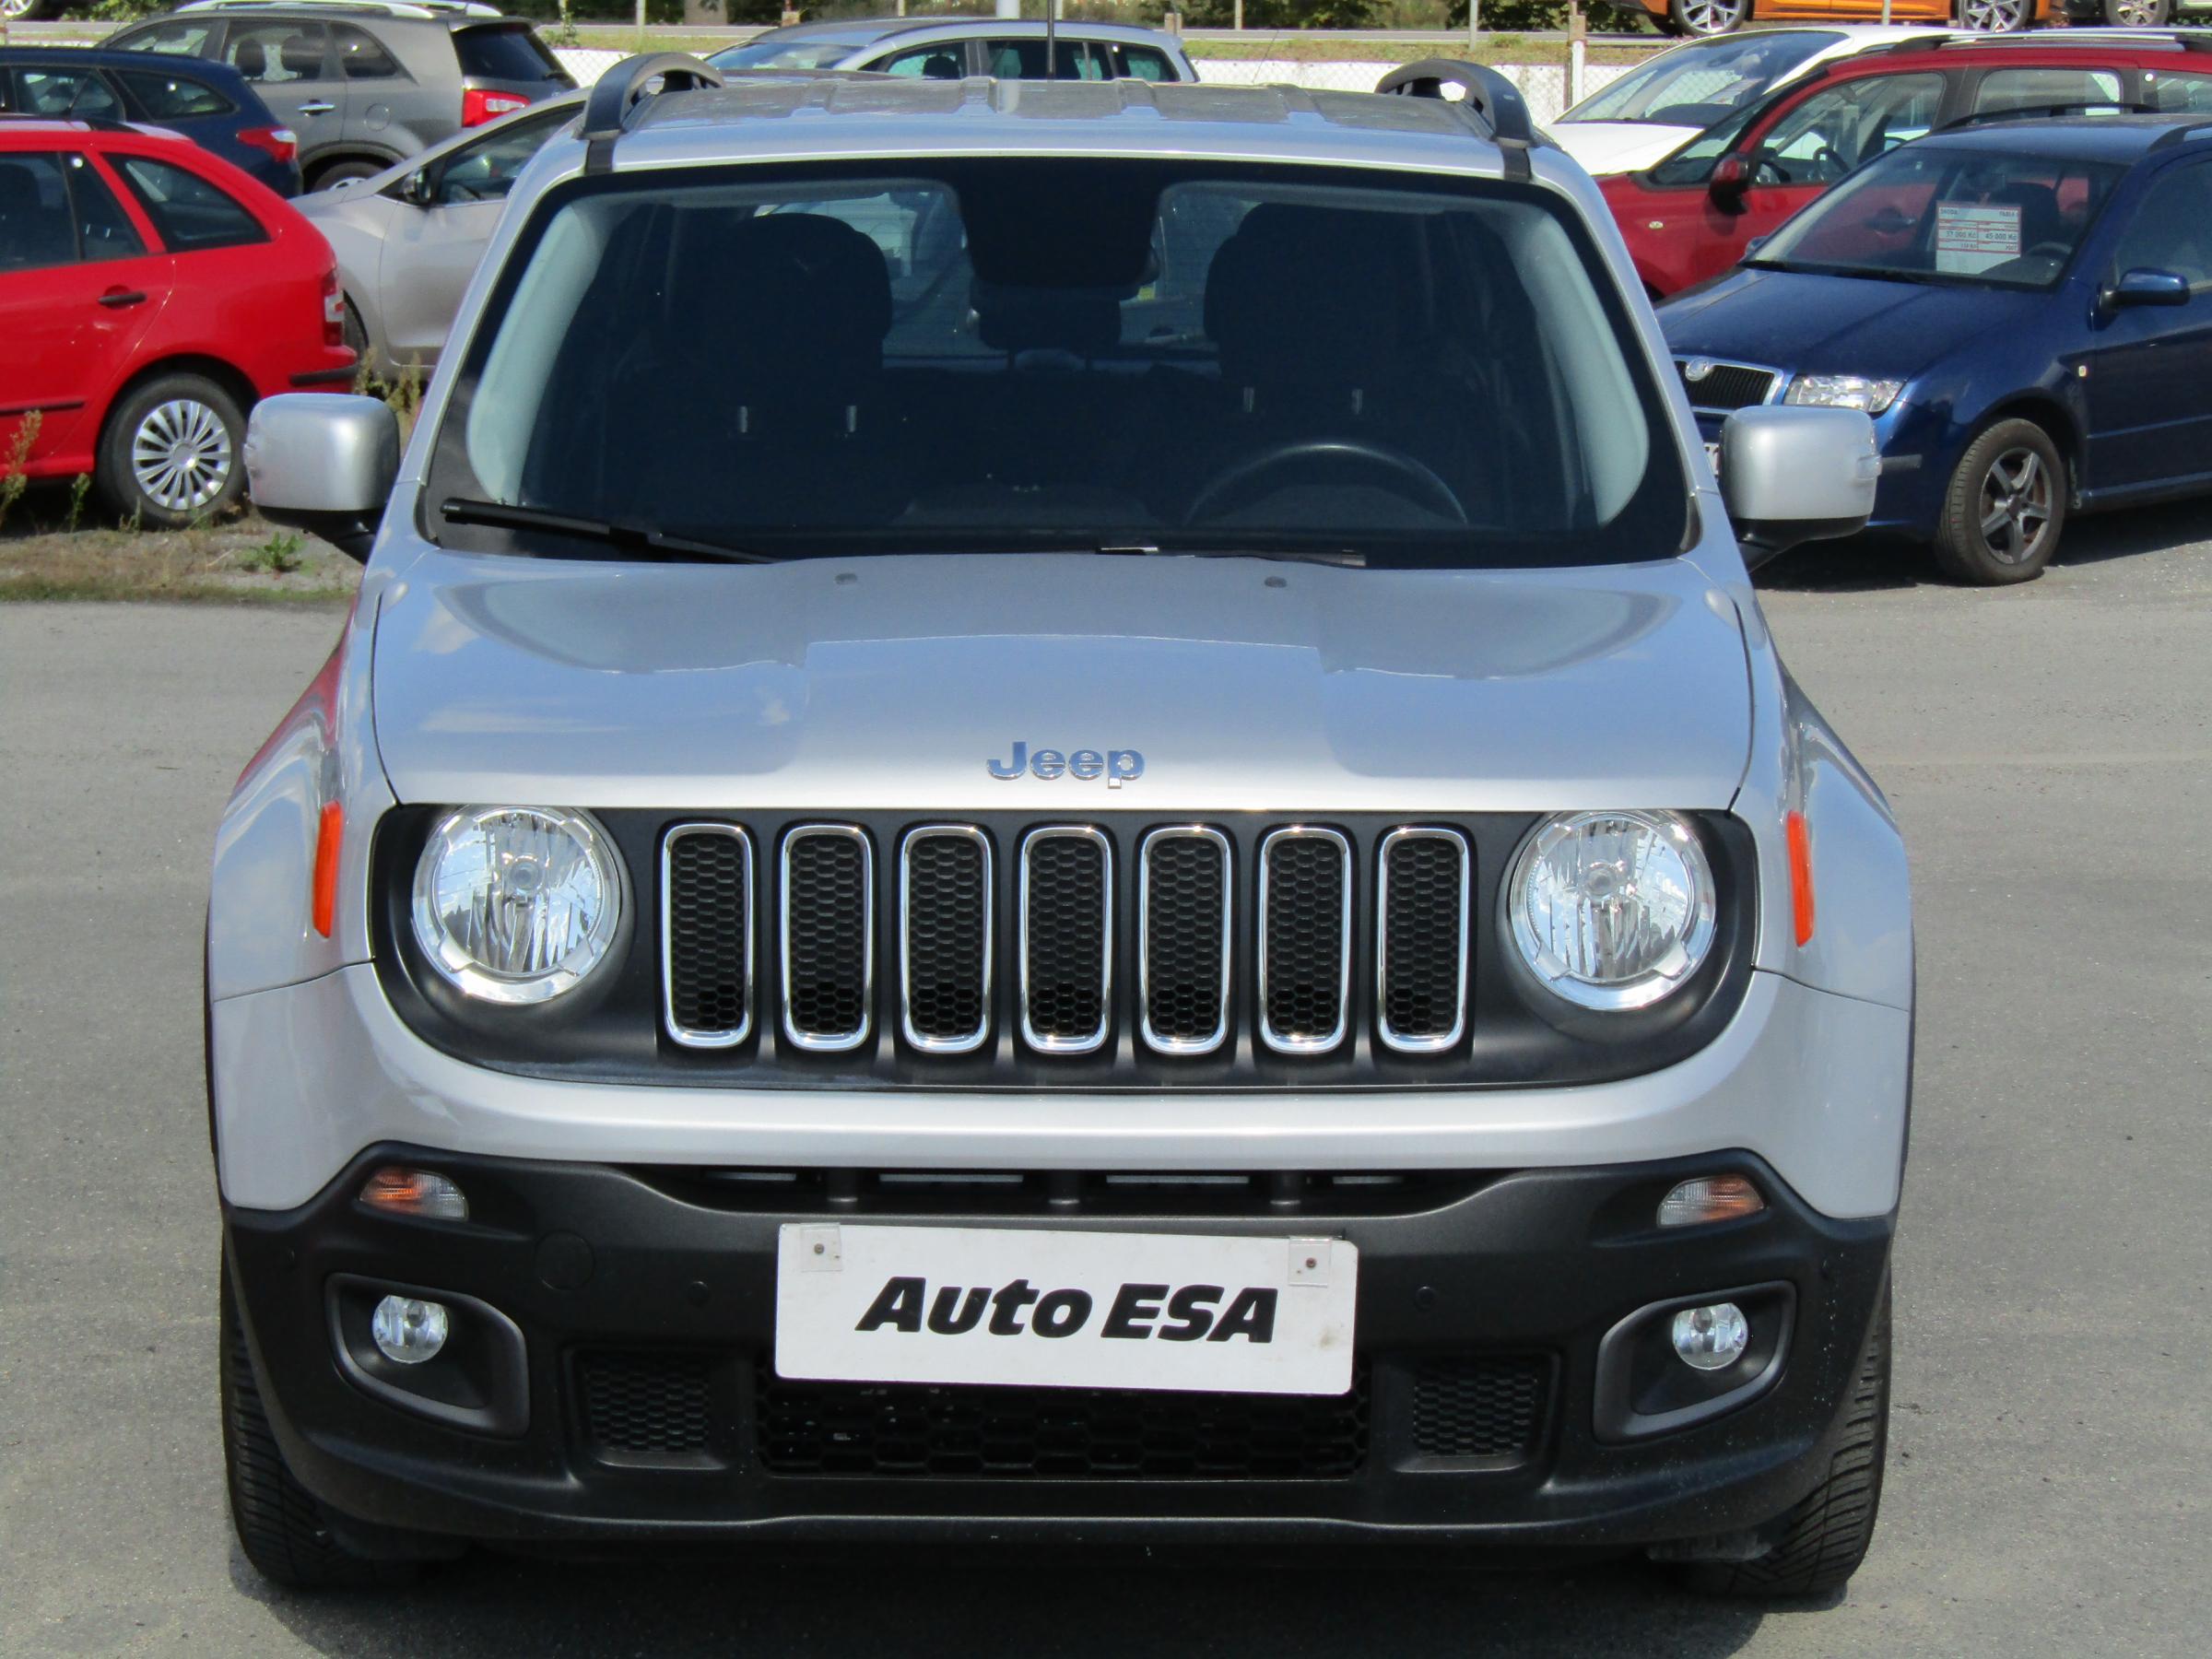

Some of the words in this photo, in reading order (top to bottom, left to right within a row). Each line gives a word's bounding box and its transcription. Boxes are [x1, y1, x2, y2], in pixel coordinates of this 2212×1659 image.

[987, 741, 1146, 790] Jeep
[854, 1276, 1094, 1338] Auto
[1100, 1283, 1279, 1344] ESA
